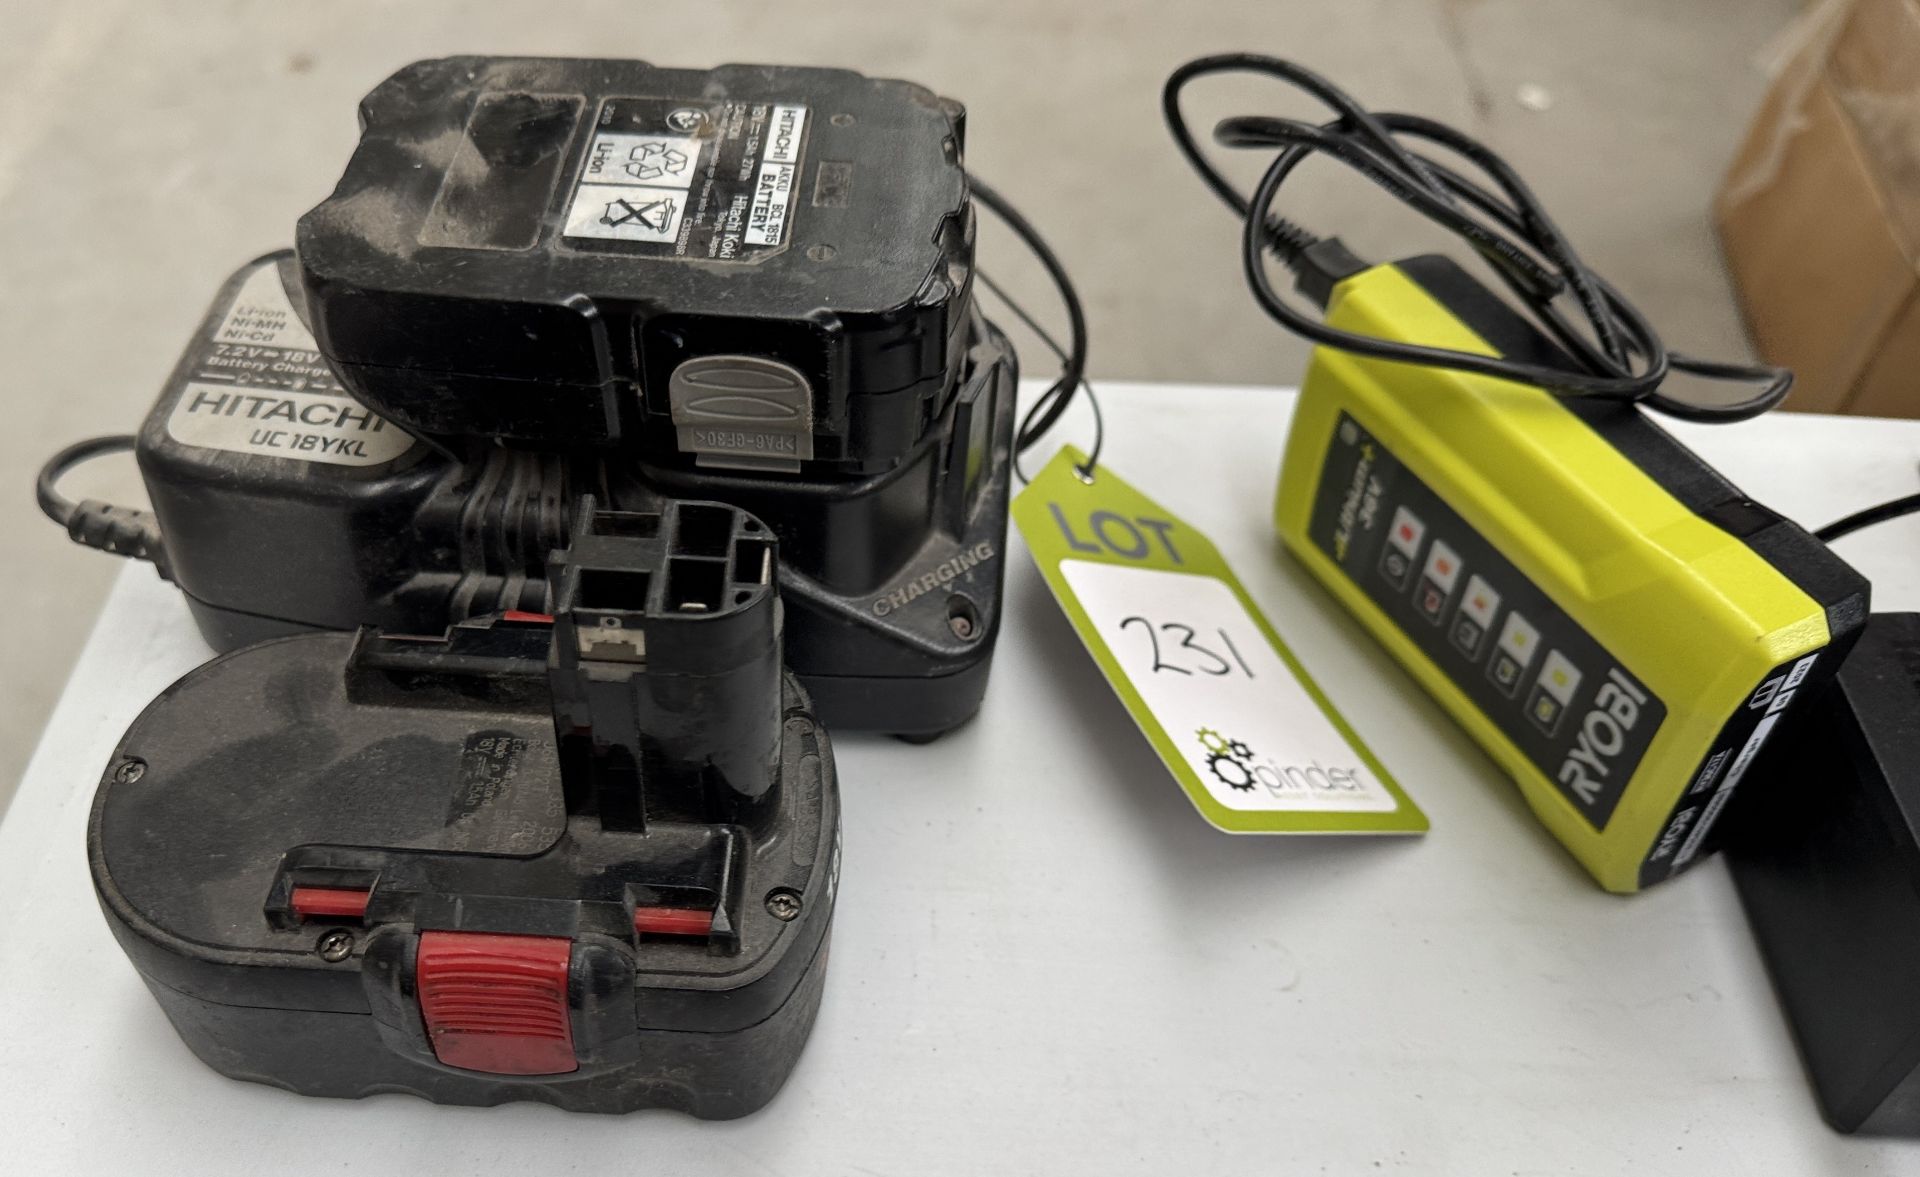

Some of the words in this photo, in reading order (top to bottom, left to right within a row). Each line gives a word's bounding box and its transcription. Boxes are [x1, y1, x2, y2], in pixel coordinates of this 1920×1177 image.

[773, 108, 797, 160] HITACHI
[588, 142, 614, 174] Li-ion
[779, 166, 792, 192] AKKU
[725, 195, 748, 231] Hitachi
[751, 173, 776, 233] BATTERY
[770, 203, 784, 219] BCL
[708, 235, 721, 258] Japan
[720, 234, 740, 258] Koki
[764, 223, 779, 243] 1815
[230, 317, 287, 331] Ni-MH
[236, 305, 287, 319] Li-ion
[223, 329, 276, 343] Ni-Cd
[205, 356, 269, 372] Battery
[273, 361, 333, 377] Charge
[188, 391, 388, 433] HITACHI
[249, 429, 289, 446] UC
[290, 433, 368, 458] 18YKL
[1047, 503, 1184, 565] LOT
[873, 541, 995, 617] CHARGING
[1119, 616, 1256, 679] 231
[478, 738, 495, 754] 18V
[494, 737, 511, 759] Made
[1557, 667, 1648, 805] RYOBI
[481, 776, 501, 807] Poland
[1252, 758, 1363, 796] pinder
